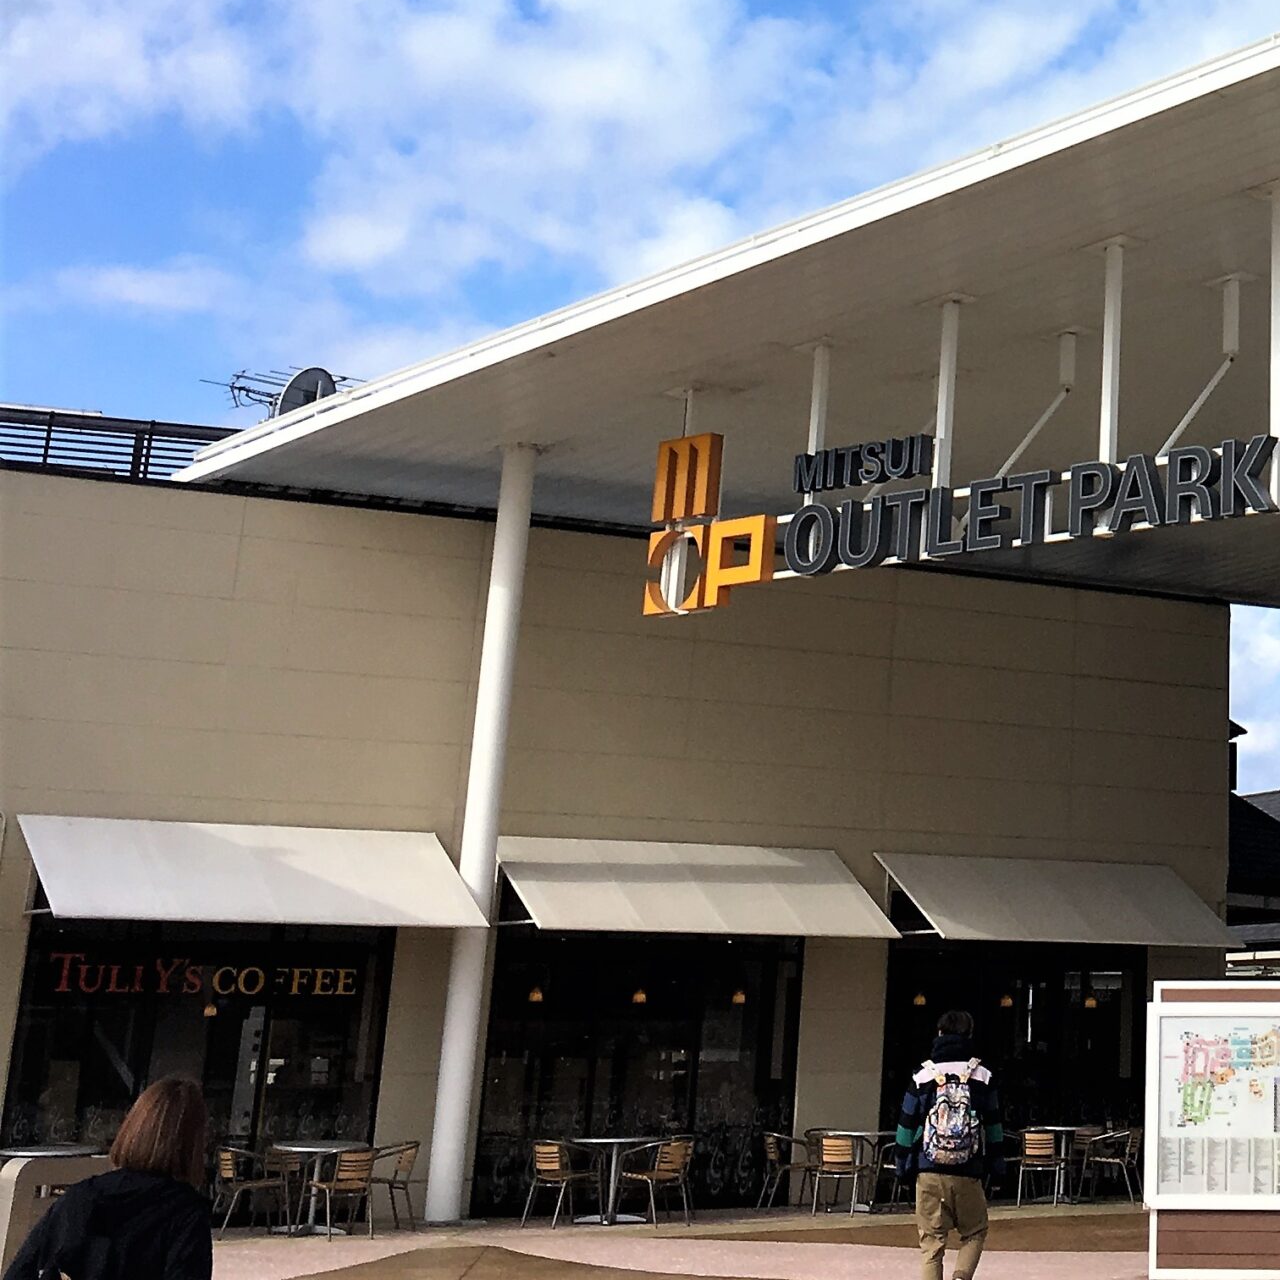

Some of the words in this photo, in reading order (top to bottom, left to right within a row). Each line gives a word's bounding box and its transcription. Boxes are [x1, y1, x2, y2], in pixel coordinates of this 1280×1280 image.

[784, 469, 1056, 576] OUTLET
[1069, 433, 1276, 537] PARK
[793, 434, 933, 493] MITSUI
